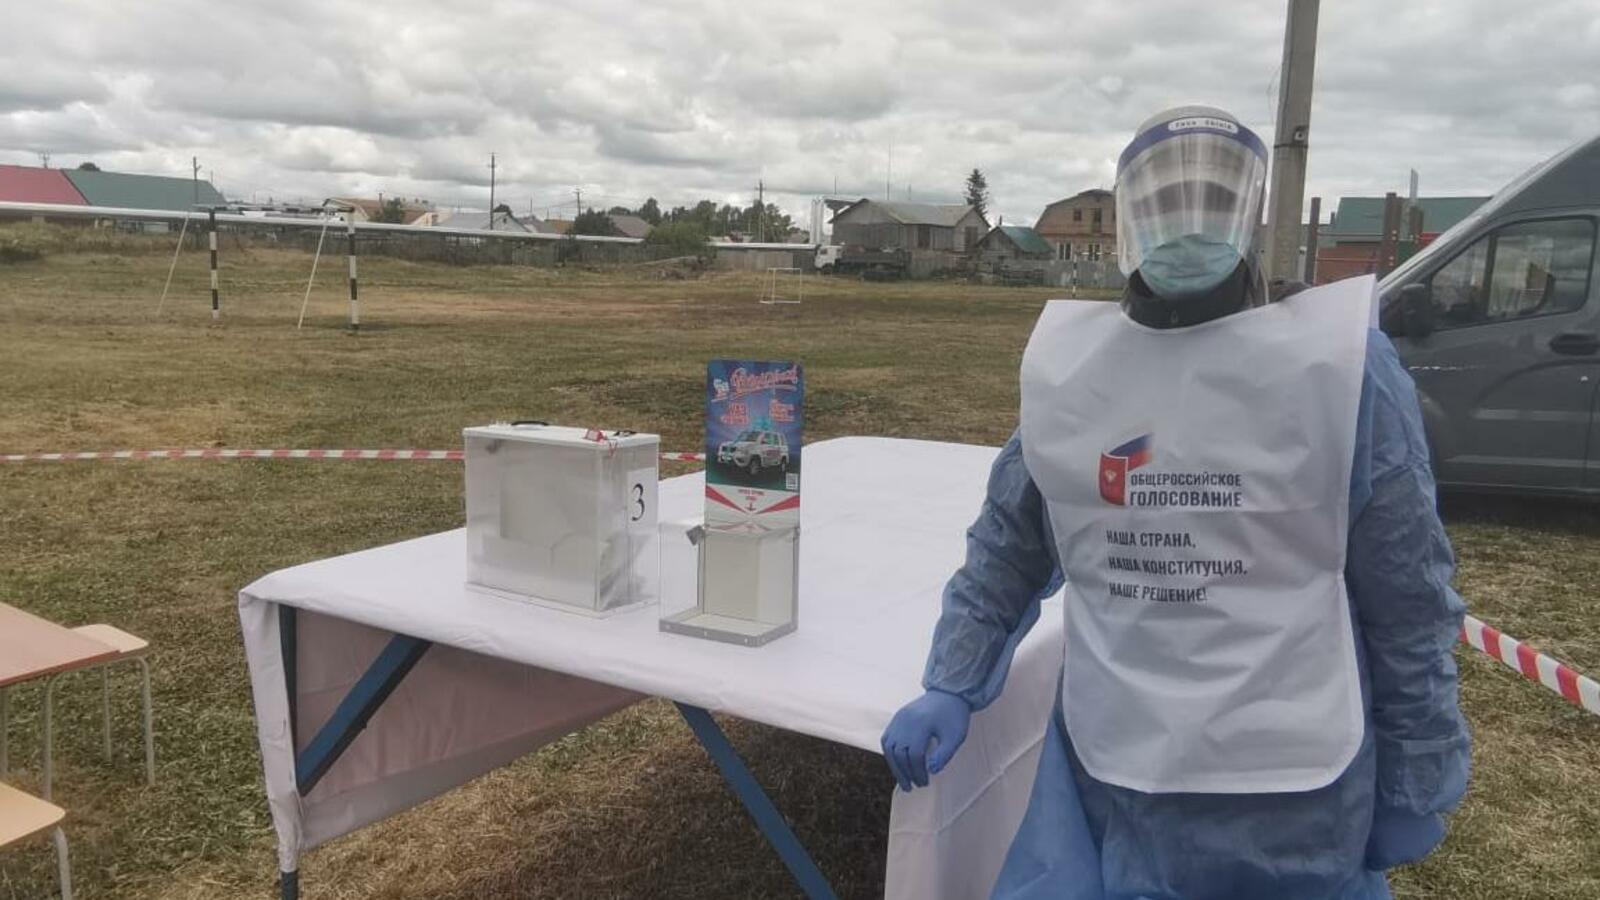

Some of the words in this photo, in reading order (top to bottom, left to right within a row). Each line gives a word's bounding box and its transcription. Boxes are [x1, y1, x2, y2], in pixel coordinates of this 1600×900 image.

[1130, 471, 1242, 487] ОБЩЕРОССИЙСКОЕ
[631, 483, 646, 521] 3
[1130, 491, 1243, 507] ГОЛОСОВАНИЕ
[1106, 530, 1137, 546] НАША
[1108, 556, 1141, 572] НАША
[1109, 582, 1140, 599] НАШЕ
[1142, 585, 1208, 602] РЕШЕНИЕ!
